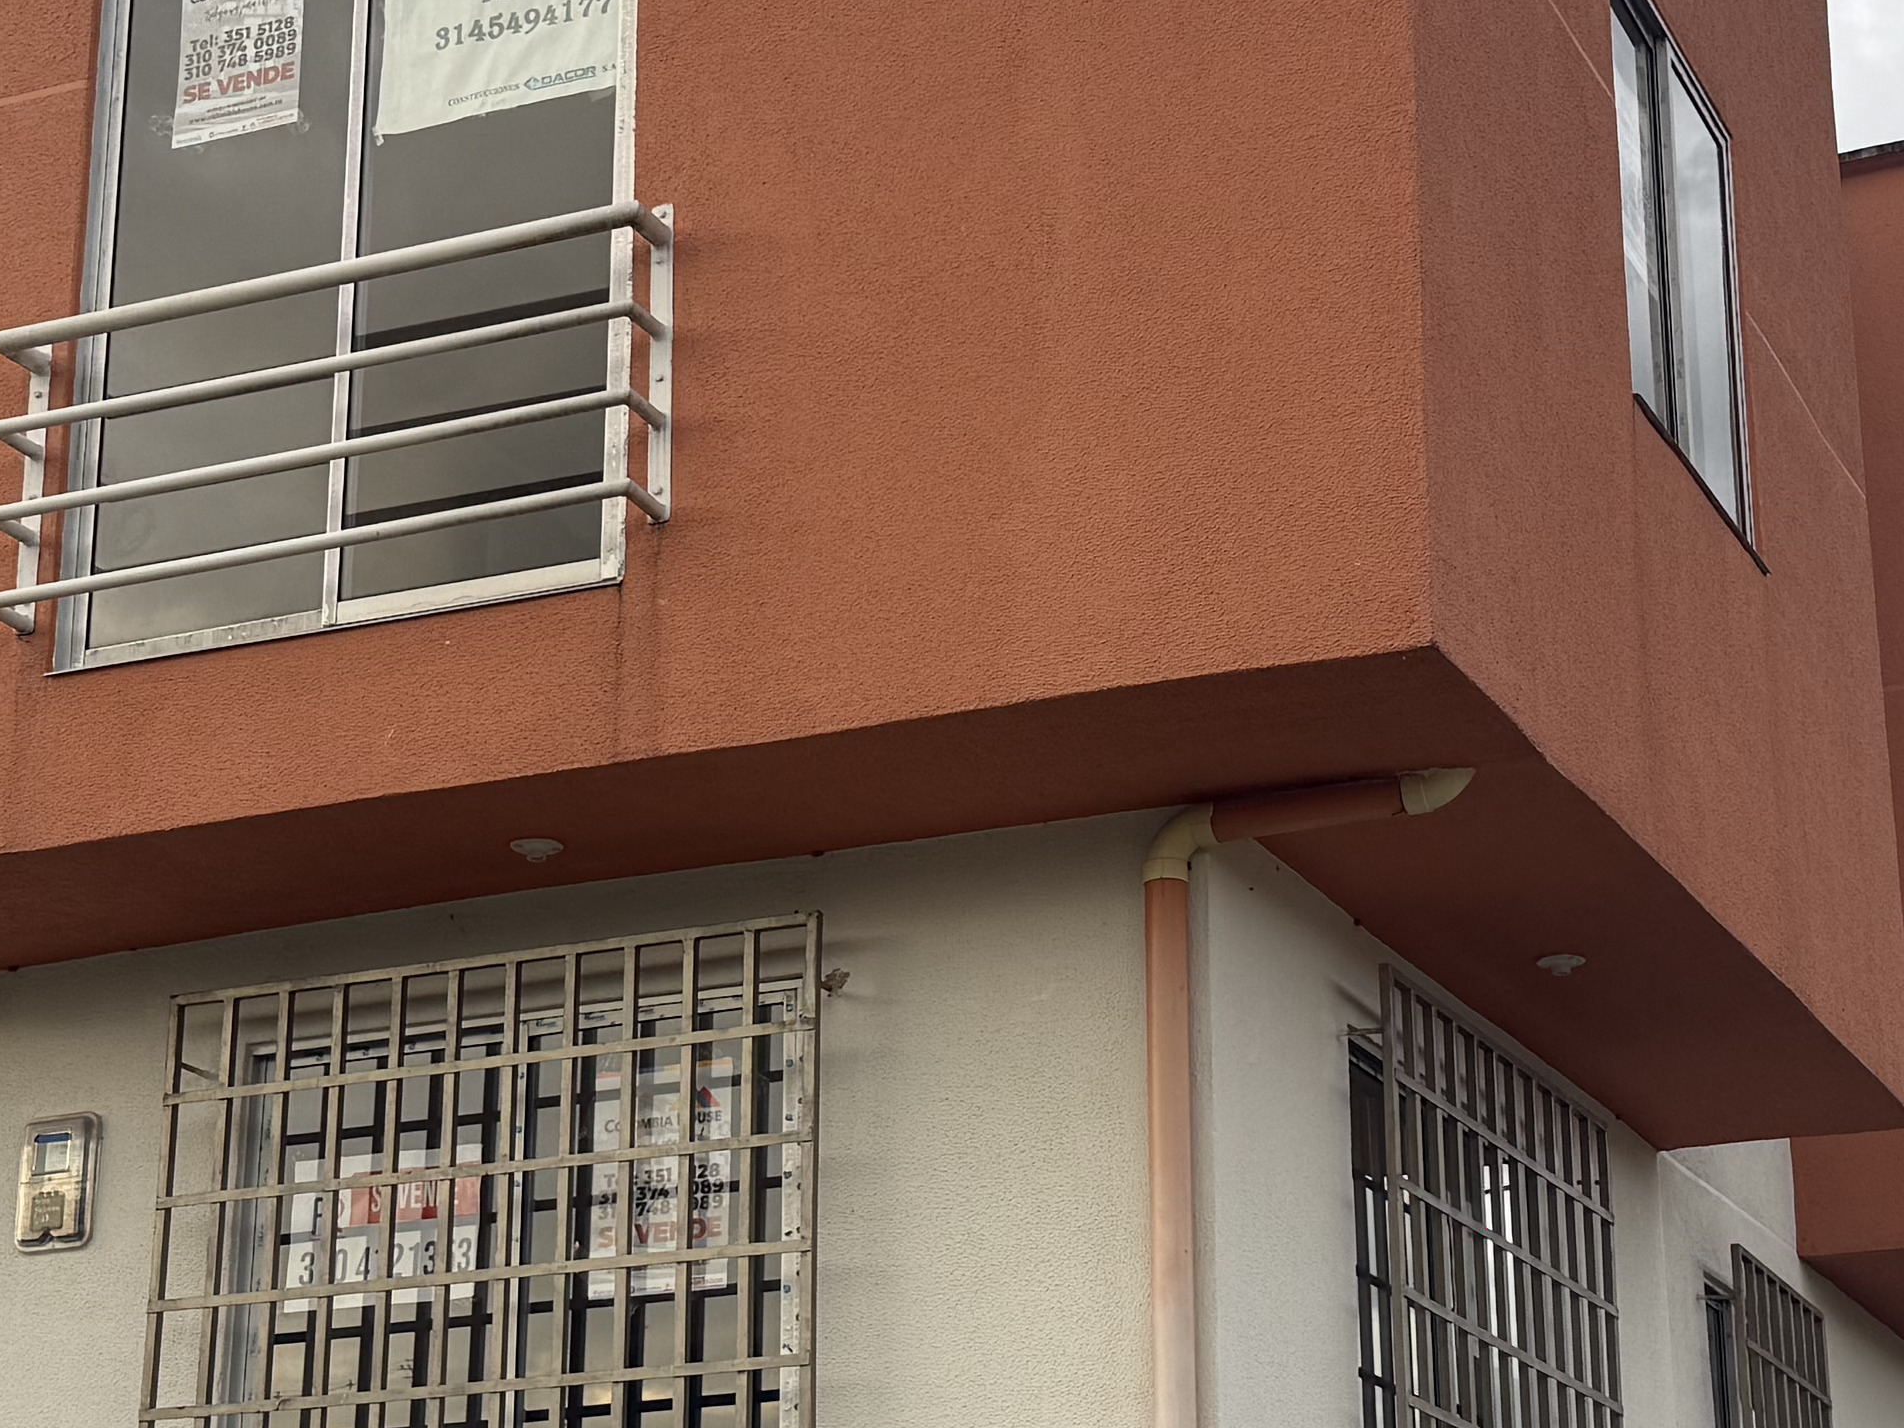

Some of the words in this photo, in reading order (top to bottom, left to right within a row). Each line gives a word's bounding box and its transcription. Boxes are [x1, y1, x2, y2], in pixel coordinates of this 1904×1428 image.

[184, 50, 212, 67] 310
[217, 40, 247, 59] 374
[253, 29, 297, 49] 0089
[190, 34, 219, 53] Tel:
[224, 27, 251, 43] 351
[257, 16, 295, 37] 5128
[184, 64, 212, 80] 310
[218, 53, 248, 73] 748
[254, 42, 297, 63] 5989
[541, 66, 596, 85] DACOR
[183, 82, 211, 104] SE
[217, 61, 295, 96] VENDE
